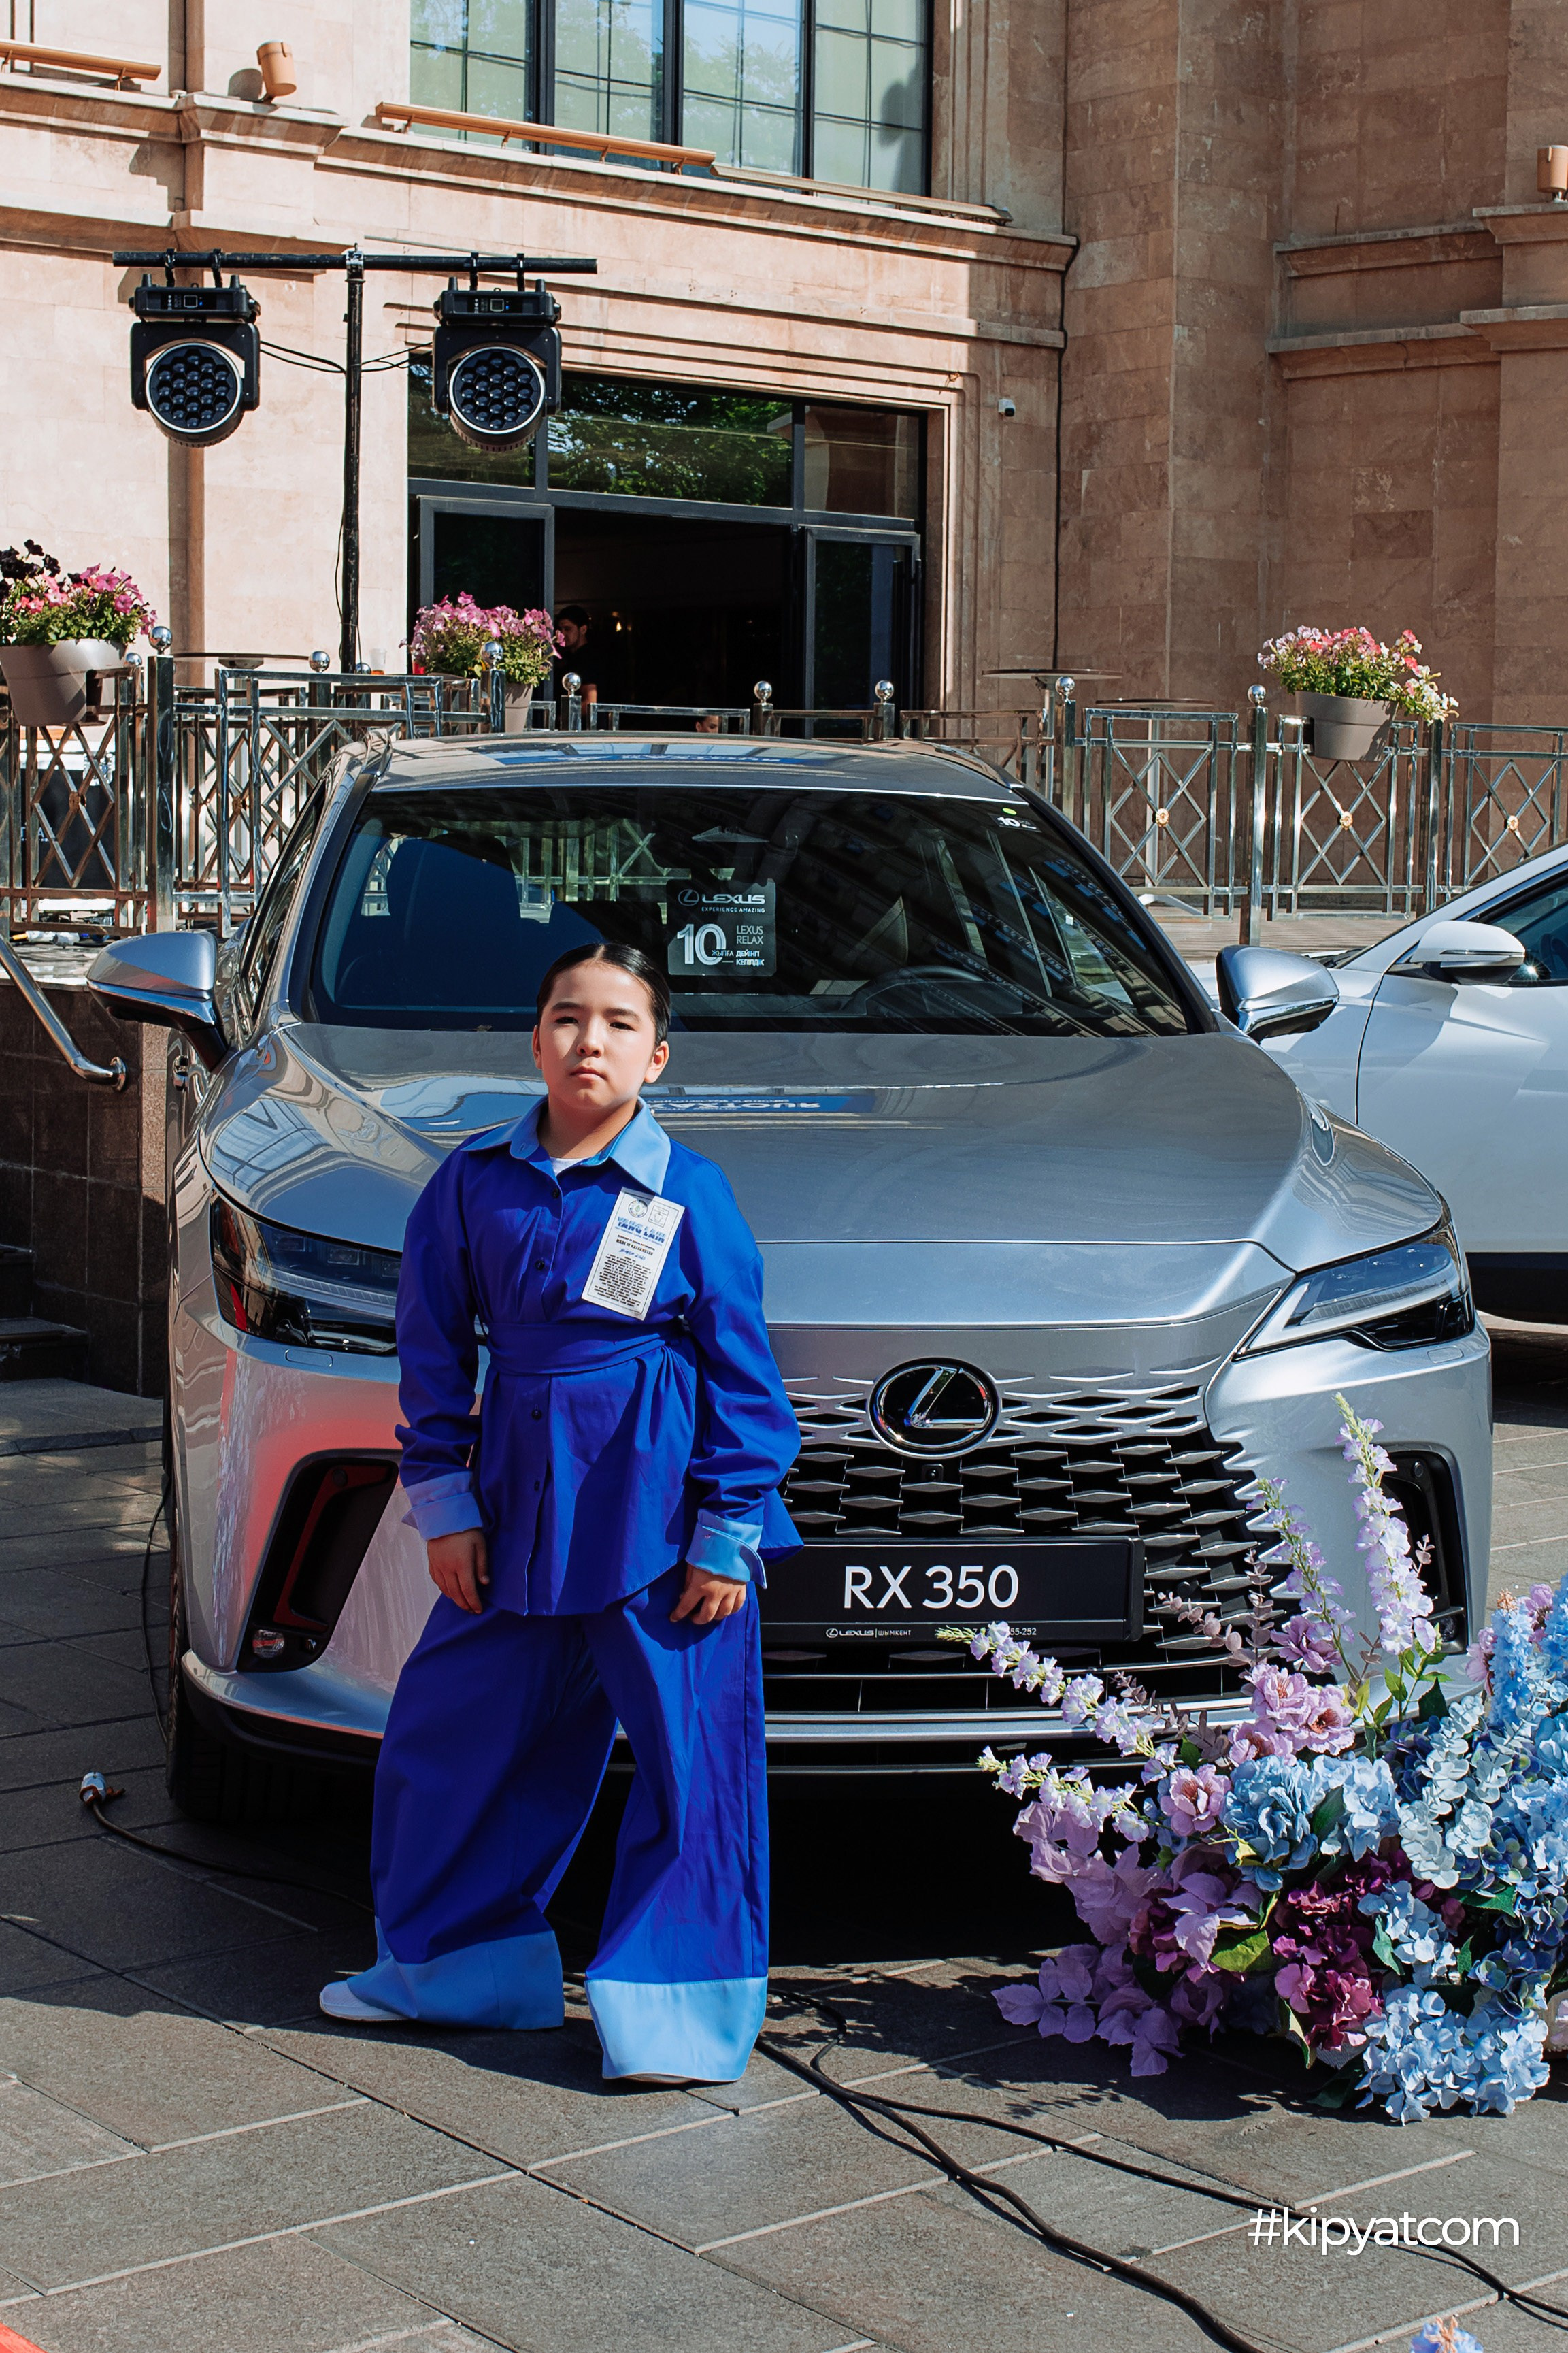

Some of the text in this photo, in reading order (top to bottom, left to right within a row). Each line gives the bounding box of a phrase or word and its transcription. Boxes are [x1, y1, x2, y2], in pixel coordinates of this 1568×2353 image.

[997, 817, 1020, 827] 10
[702, 894, 765, 904] LEXUS
[737, 925, 764, 935] LEXUS
[677, 923, 727, 965] 10
[737, 936, 764, 945] RELAX
[844, 1564, 1019, 1609] RX 350
[1010, 1627, 1037, 1636] 55-252
